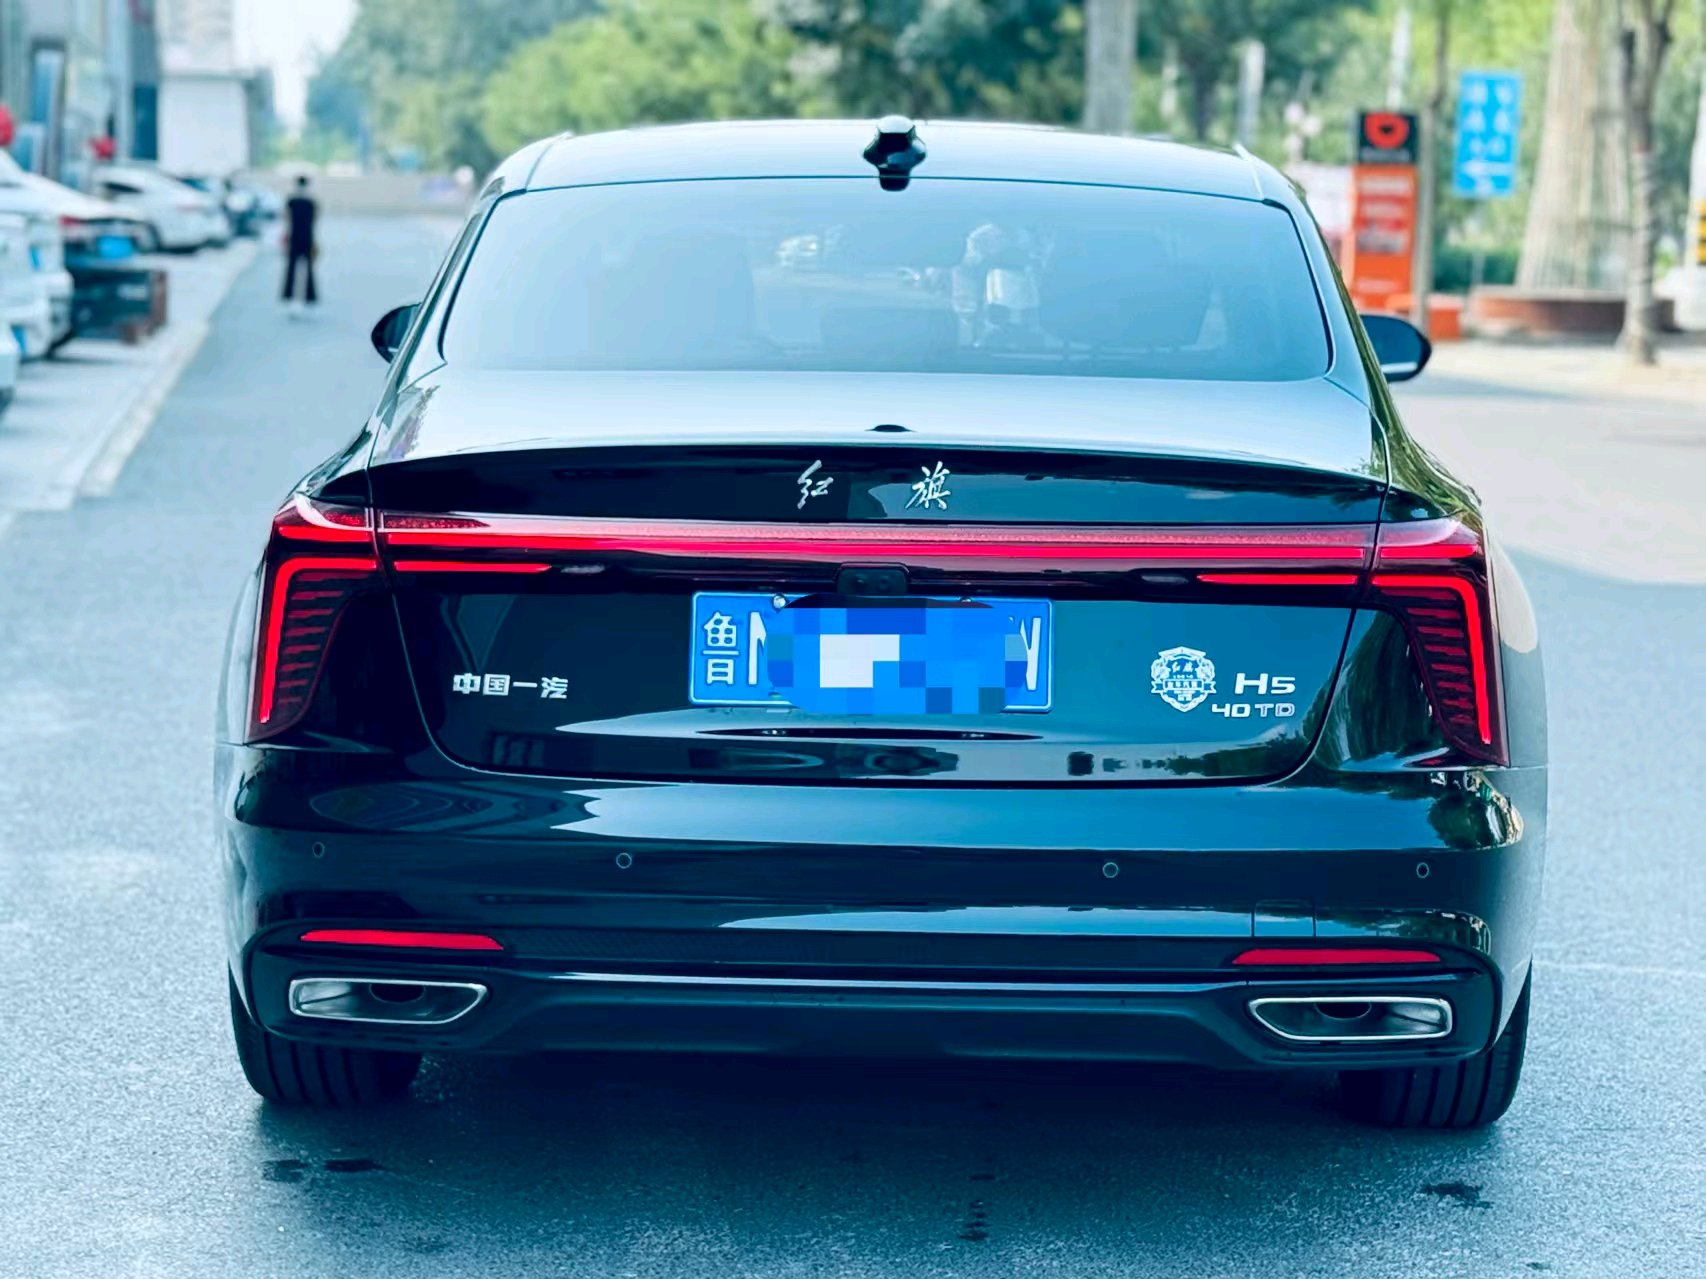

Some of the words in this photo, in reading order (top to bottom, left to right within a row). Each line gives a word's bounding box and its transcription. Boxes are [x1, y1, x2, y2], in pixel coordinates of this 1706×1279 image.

[797, 459, 951, 511] 红旗
[452, 672, 569, 700] 中国一汽
[1234, 672, 1296, 695] H5
